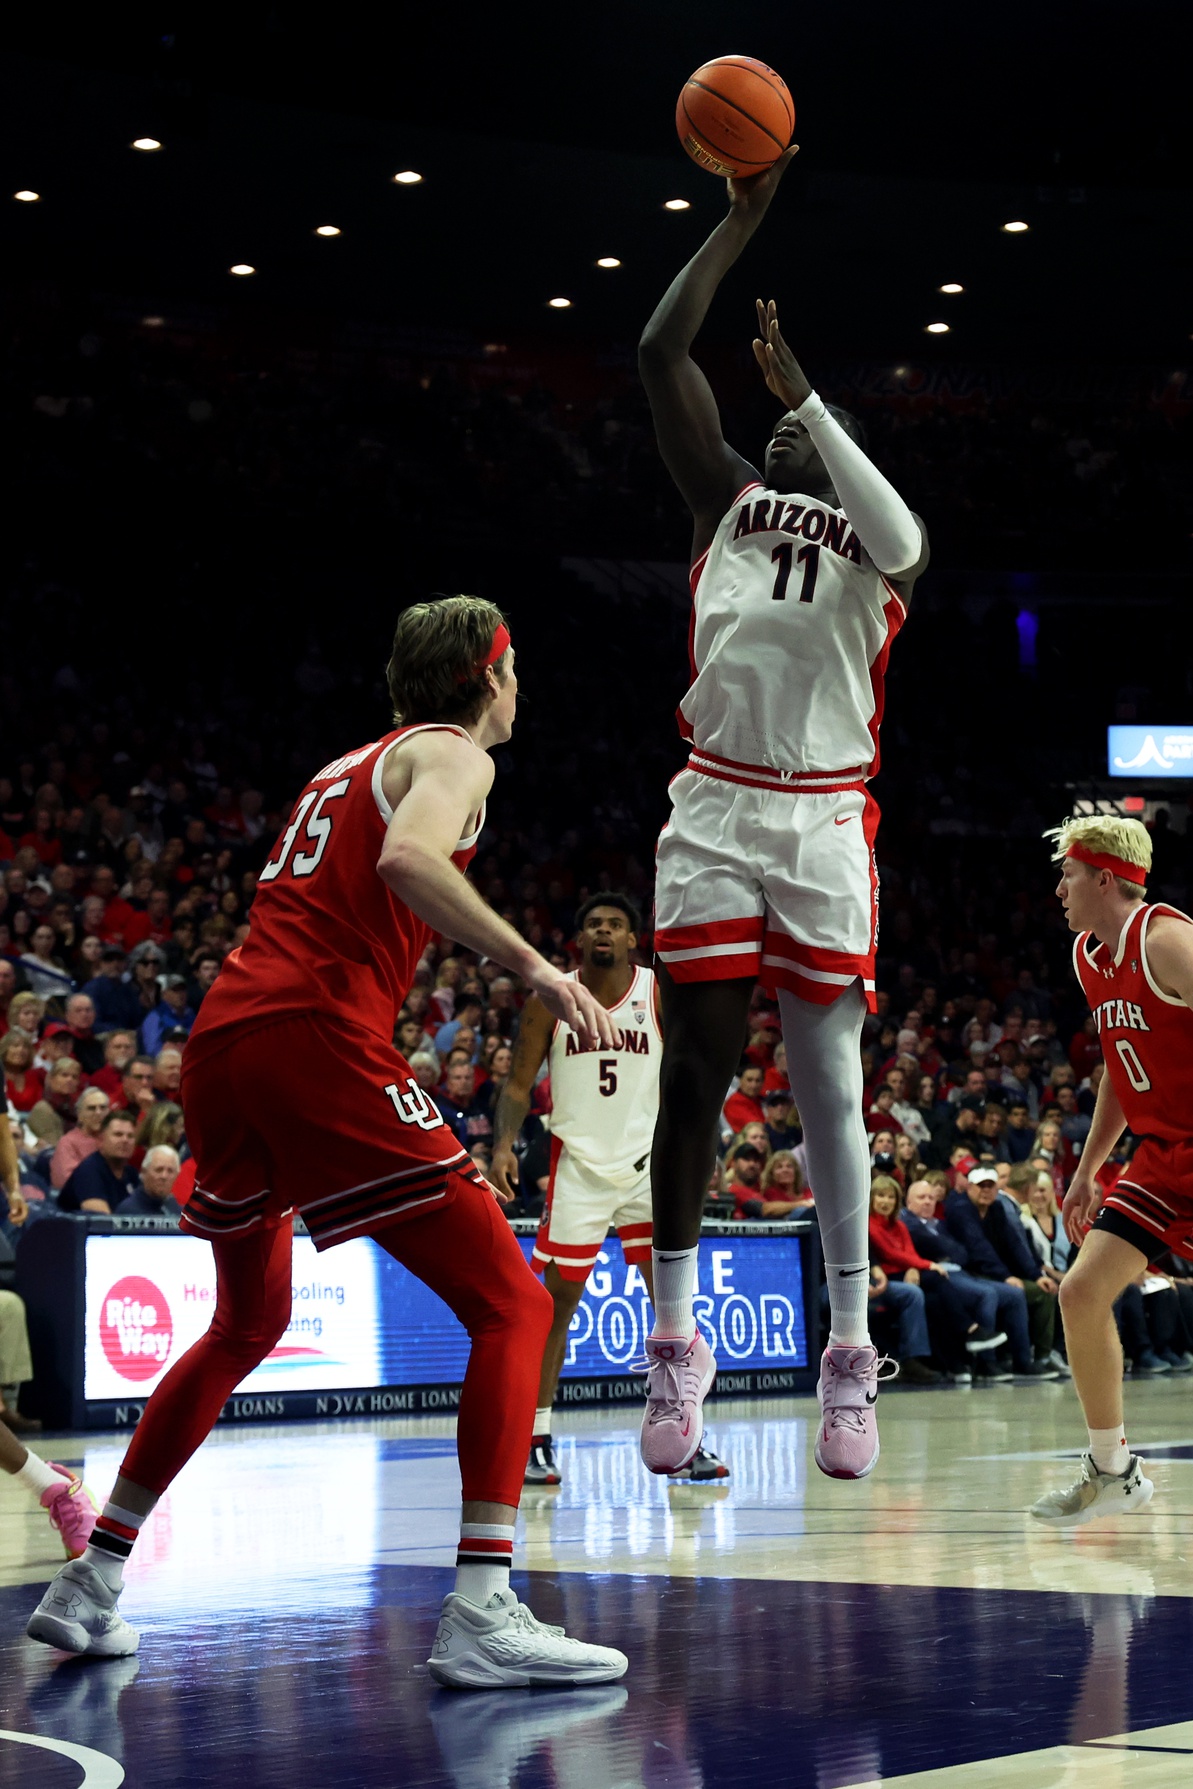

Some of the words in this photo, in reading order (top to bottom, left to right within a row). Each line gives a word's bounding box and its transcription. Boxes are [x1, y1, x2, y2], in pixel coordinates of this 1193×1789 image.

[733, 499, 861, 565] ARIZONA
[771, 543, 820, 603] 11
[258, 777, 351, 881] 35
[1093, 1000, 1150, 1034] UTAH
[599, 1059, 617, 1097] 5
[1115, 1039, 1151, 1092] 0
[586, 1251, 735, 1297] GAE
[106, 1297, 157, 1327] Rite
[117, 1327, 170, 1361] Way
[563, 1383, 602, 1401] HOME
[716, 1375, 752, 1392] HOME
[757, 1372, 794, 1390] LOANS
[233, 1397, 285, 1418] LOANS
[370, 1391, 414, 1412] HOME
[421, 1388, 463, 1407] LOAN
